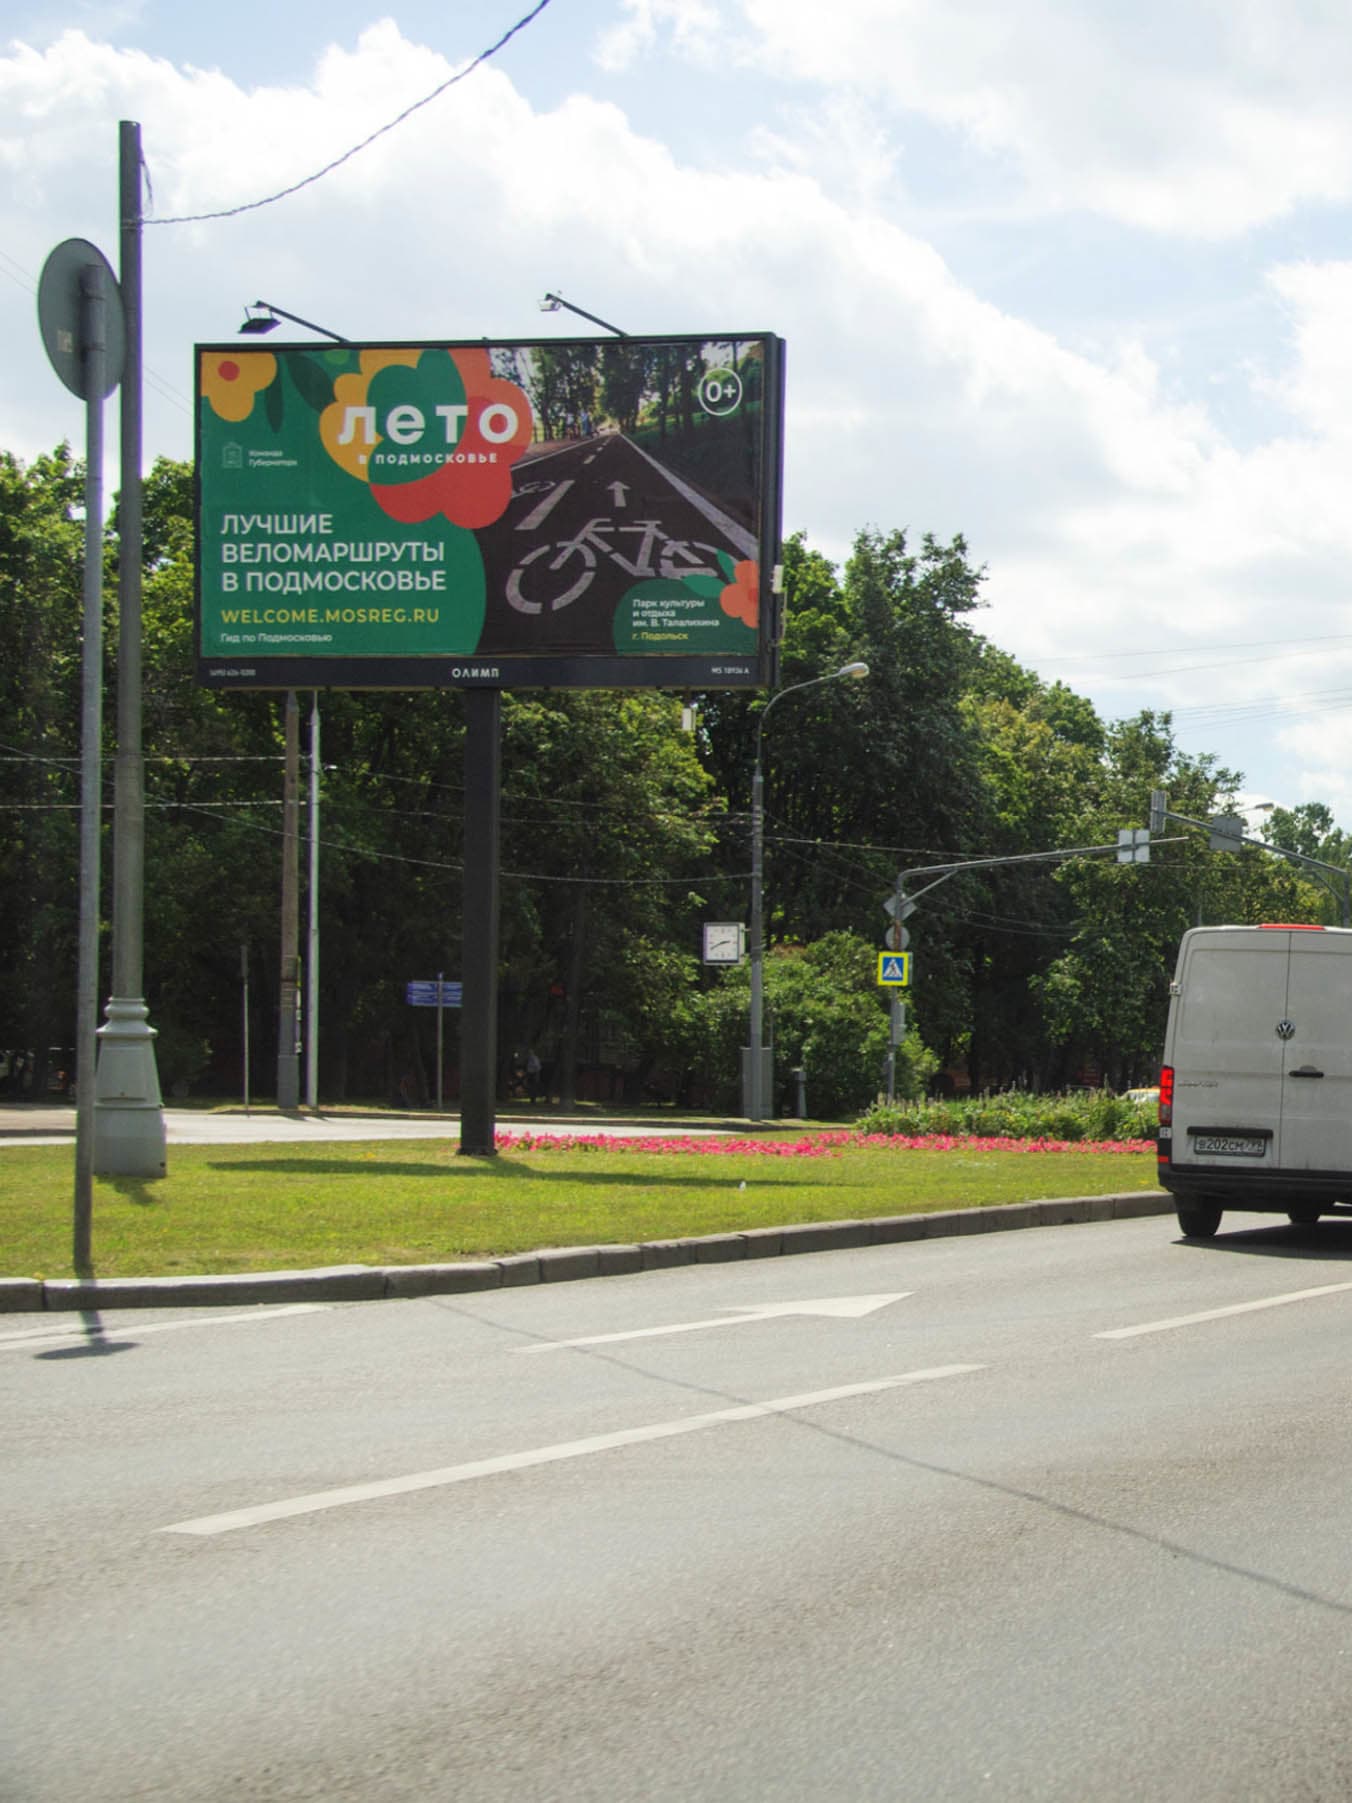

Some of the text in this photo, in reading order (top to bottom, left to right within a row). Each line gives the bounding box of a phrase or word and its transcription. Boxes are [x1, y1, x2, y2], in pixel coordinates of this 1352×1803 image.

[705, 381, 737, 402] 0+
[374, 452, 498, 466] ПОДМОСКОВЬЕ
[220, 513, 334, 535] ЛУЧШИЕ
[221, 541, 446, 564] ВЕЛОМАРШРУТЫ
[222, 570, 448, 595] В ПОДМОСКОВЬЕ
[632, 599, 705, 609] Парк культуры
[220, 608, 440, 624] WELCOME.MOSREG.RU
[641, 610, 676, 618] отдыха
[220, 632, 333, 644] Гид по Подмосковью
[640, 631, 689, 641] Подольск
[451, 667, 500, 678] ОЛИМП
